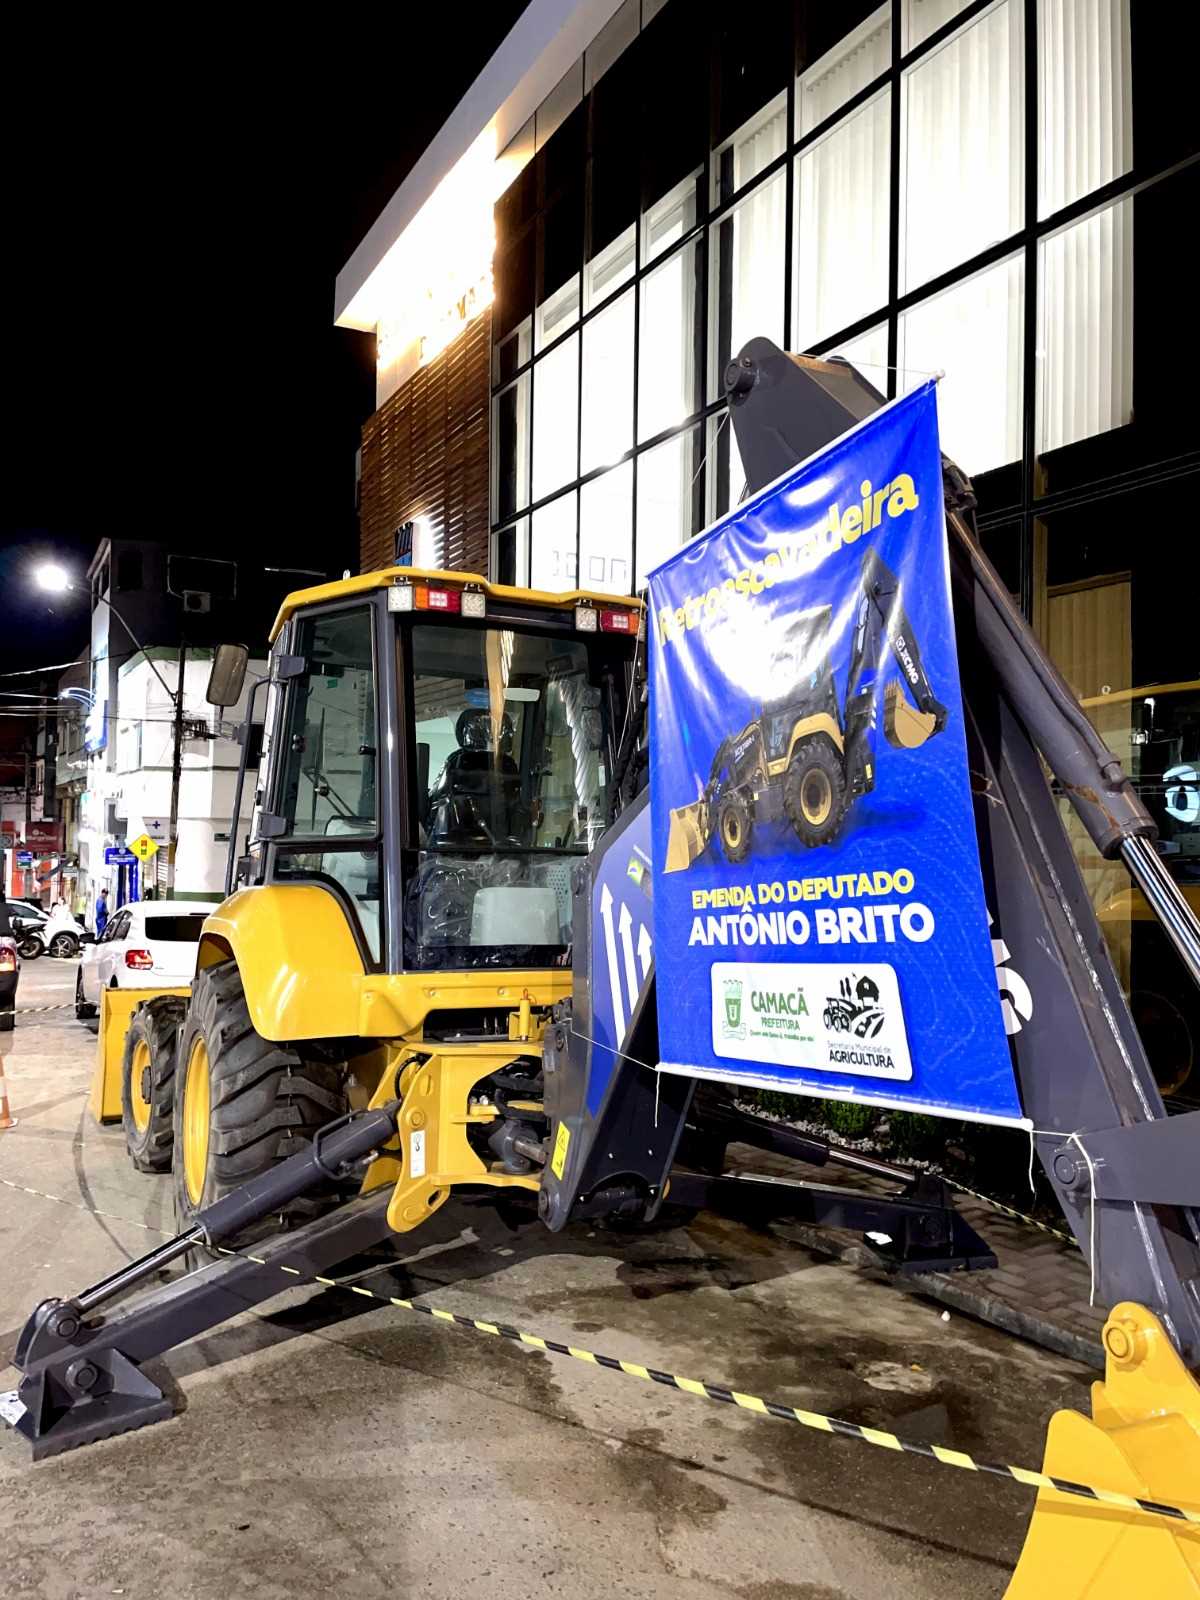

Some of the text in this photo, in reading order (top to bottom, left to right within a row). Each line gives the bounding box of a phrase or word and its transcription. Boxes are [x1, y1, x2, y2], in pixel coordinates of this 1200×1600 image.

[899, 648, 919, 685] XCMG
[692, 868, 915, 909] EMENDA DO DEPUTADO
[688, 902, 936, 946] ANTÔNIO BRITO
[751, 987, 810, 1017] CAMACÃ
[761, 1017, 801, 1031] PREFEITURA
[829, 1049, 895, 1069] AGRICULTURA
